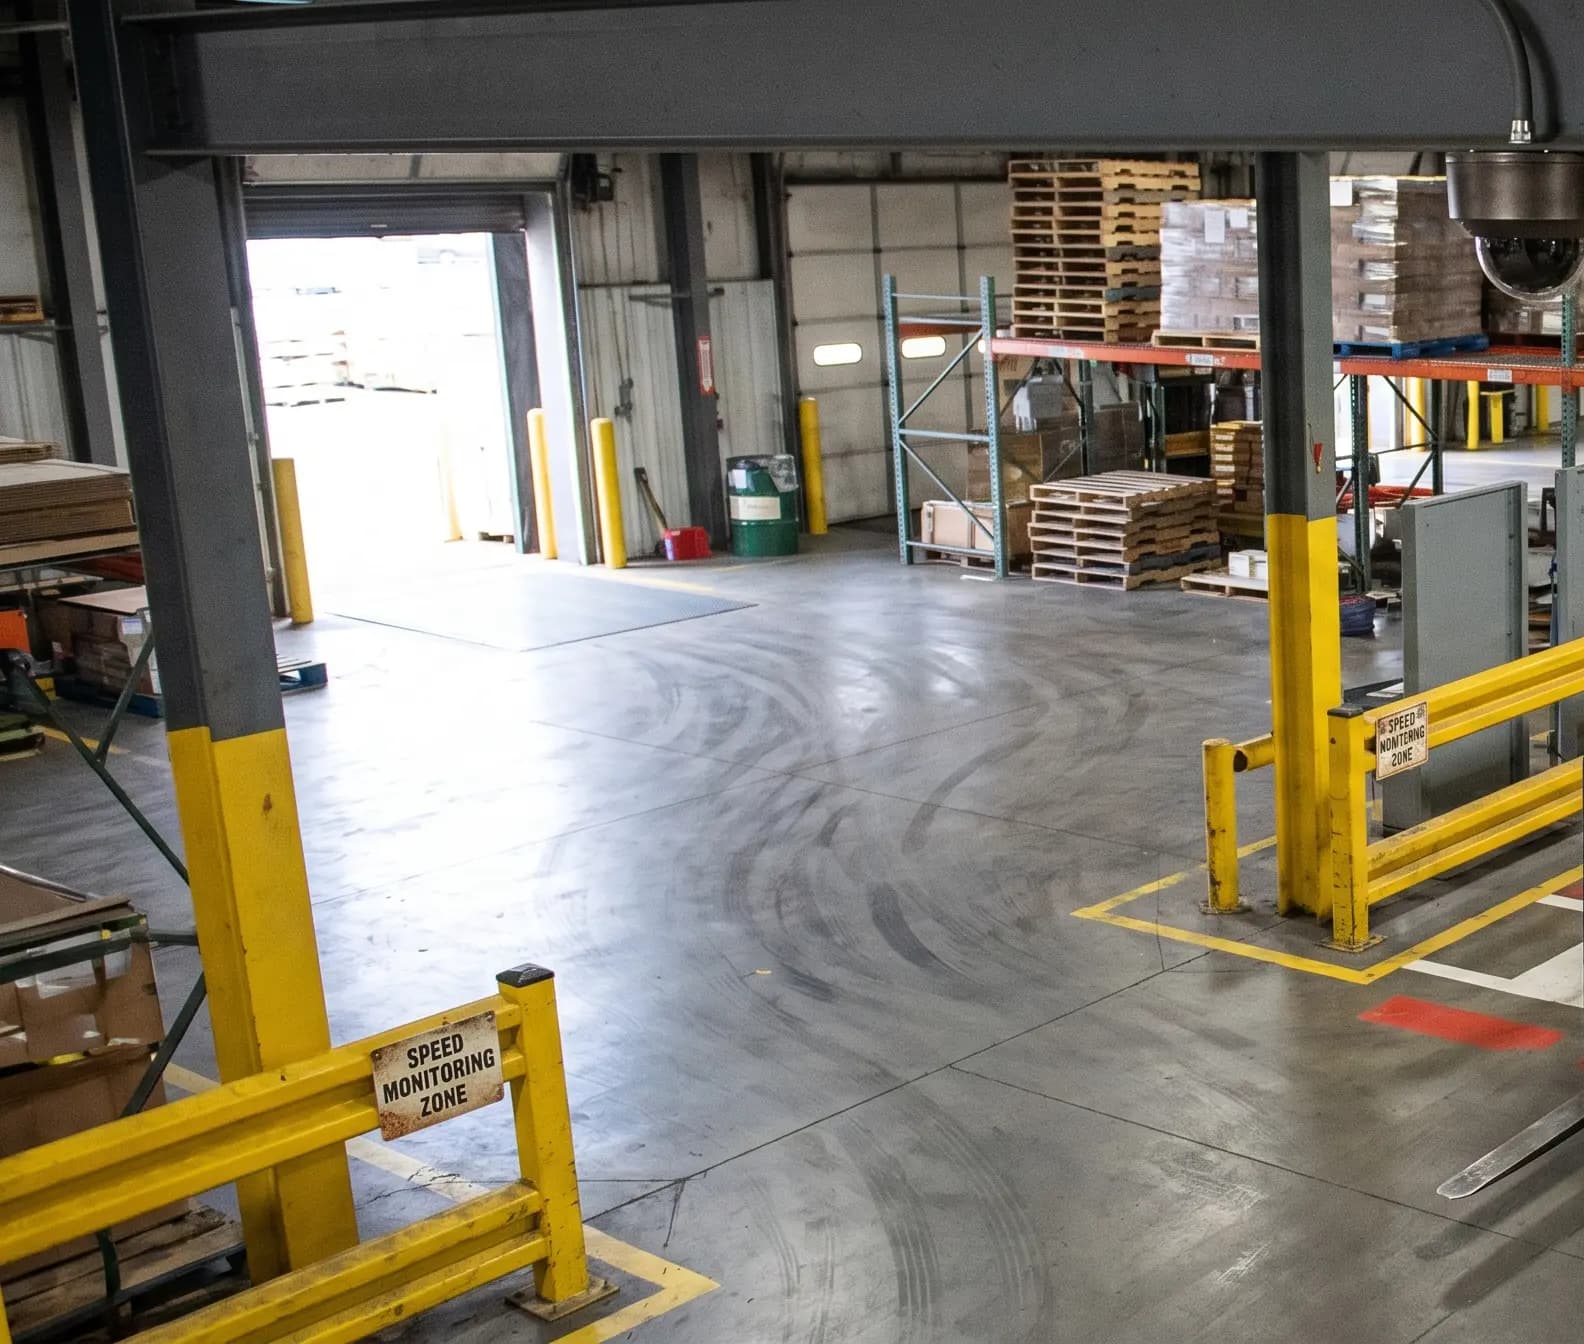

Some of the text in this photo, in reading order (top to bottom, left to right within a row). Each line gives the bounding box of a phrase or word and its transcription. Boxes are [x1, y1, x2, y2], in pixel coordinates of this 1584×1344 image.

[1388, 712, 1415, 733] SPEED
[407, 1033, 463, 1068] SPEED
[383, 1048, 495, 1104] MONITORING
[420, 1084, 467, 1117] ZONE
